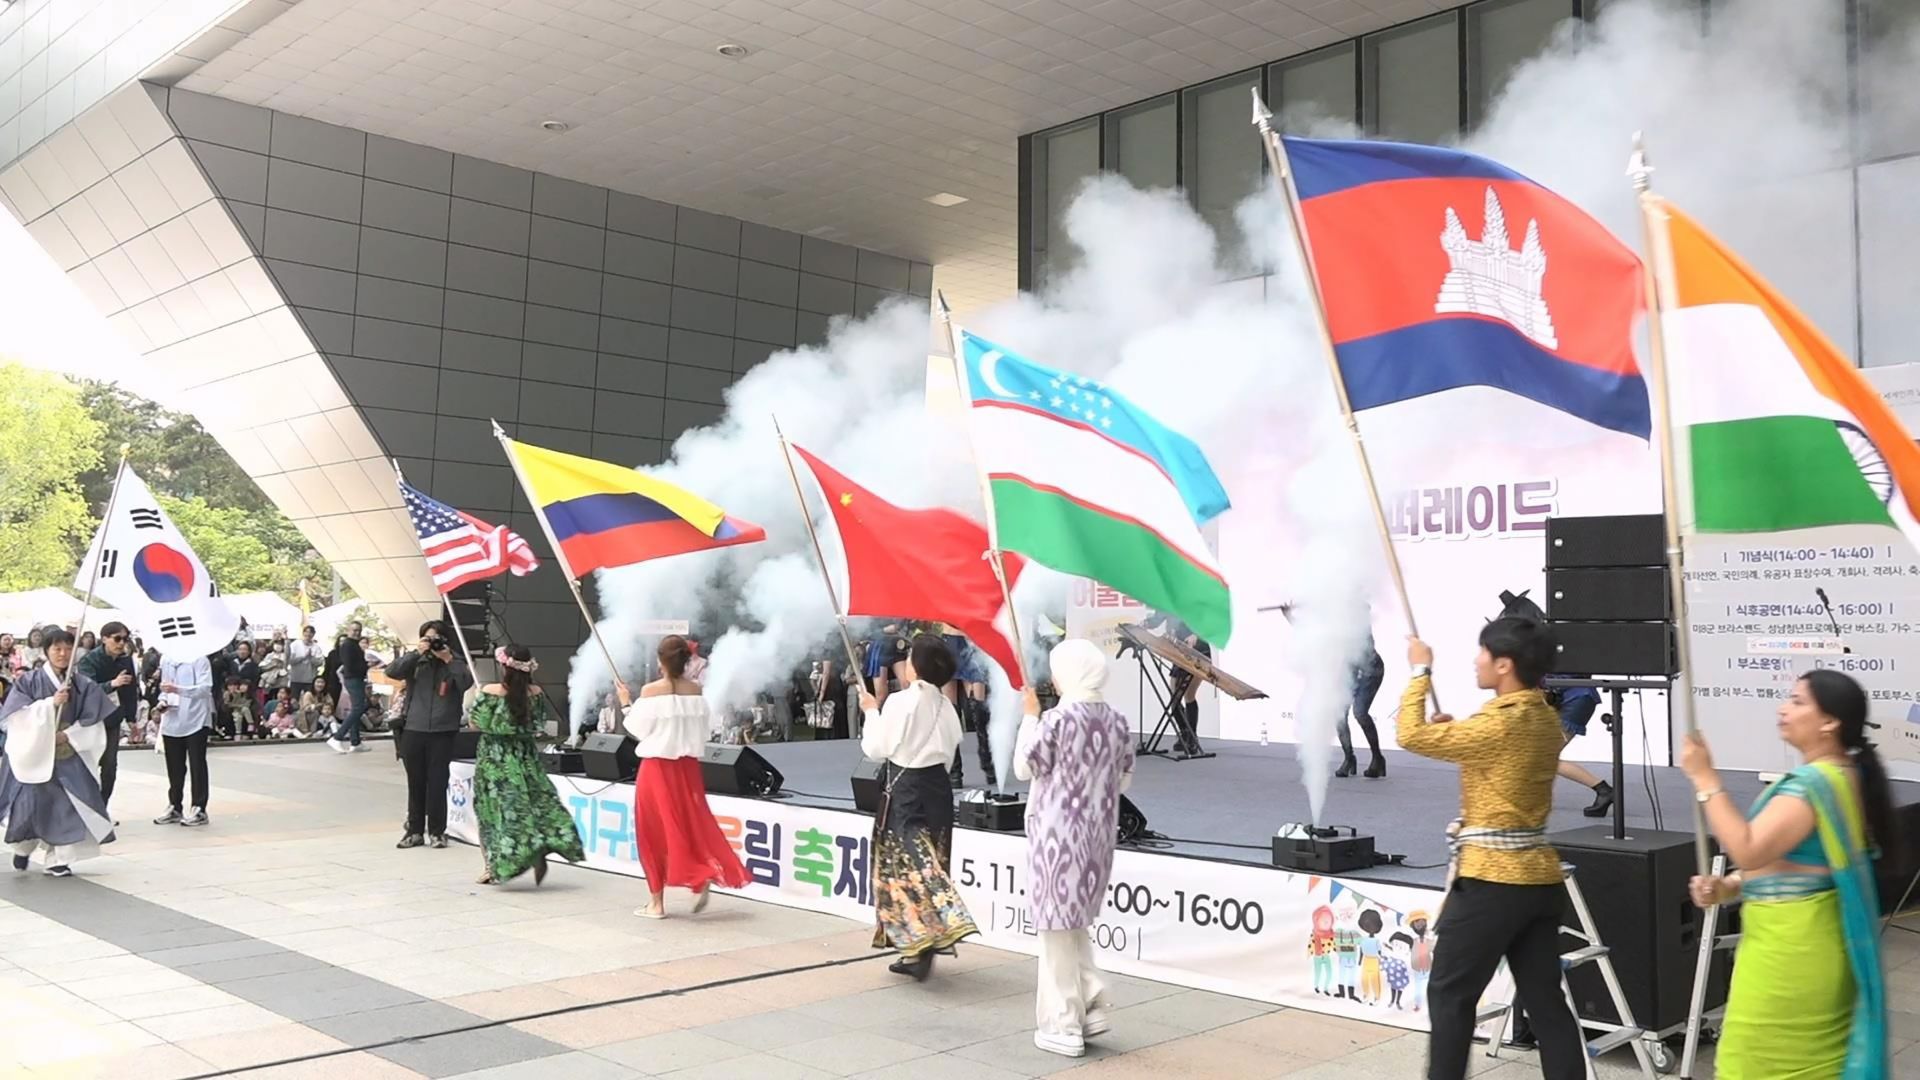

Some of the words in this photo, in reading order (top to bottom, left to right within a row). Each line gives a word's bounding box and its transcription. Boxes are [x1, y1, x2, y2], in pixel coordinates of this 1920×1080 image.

[1389, 480, 1552, 536] 퍼레이드
[1739, 549, 1816, 562] 기념식(14:00
[1830, 546, 1874, 559] 14:40)
[1072, 579, 1144, 609] 어울
[1736, 604, 1824, 617] 식후공연(14:40
[1839, 603, 1882, 616] 16:00)
[1839, 659, 1884, 672] 16:00)
[1690, 686, 1710, 697] 가별
[568, 795, 637, 861] 지구
[792, 827, 876, 907] 축제
[1107, 881, 1264, 935] :00~16:00
